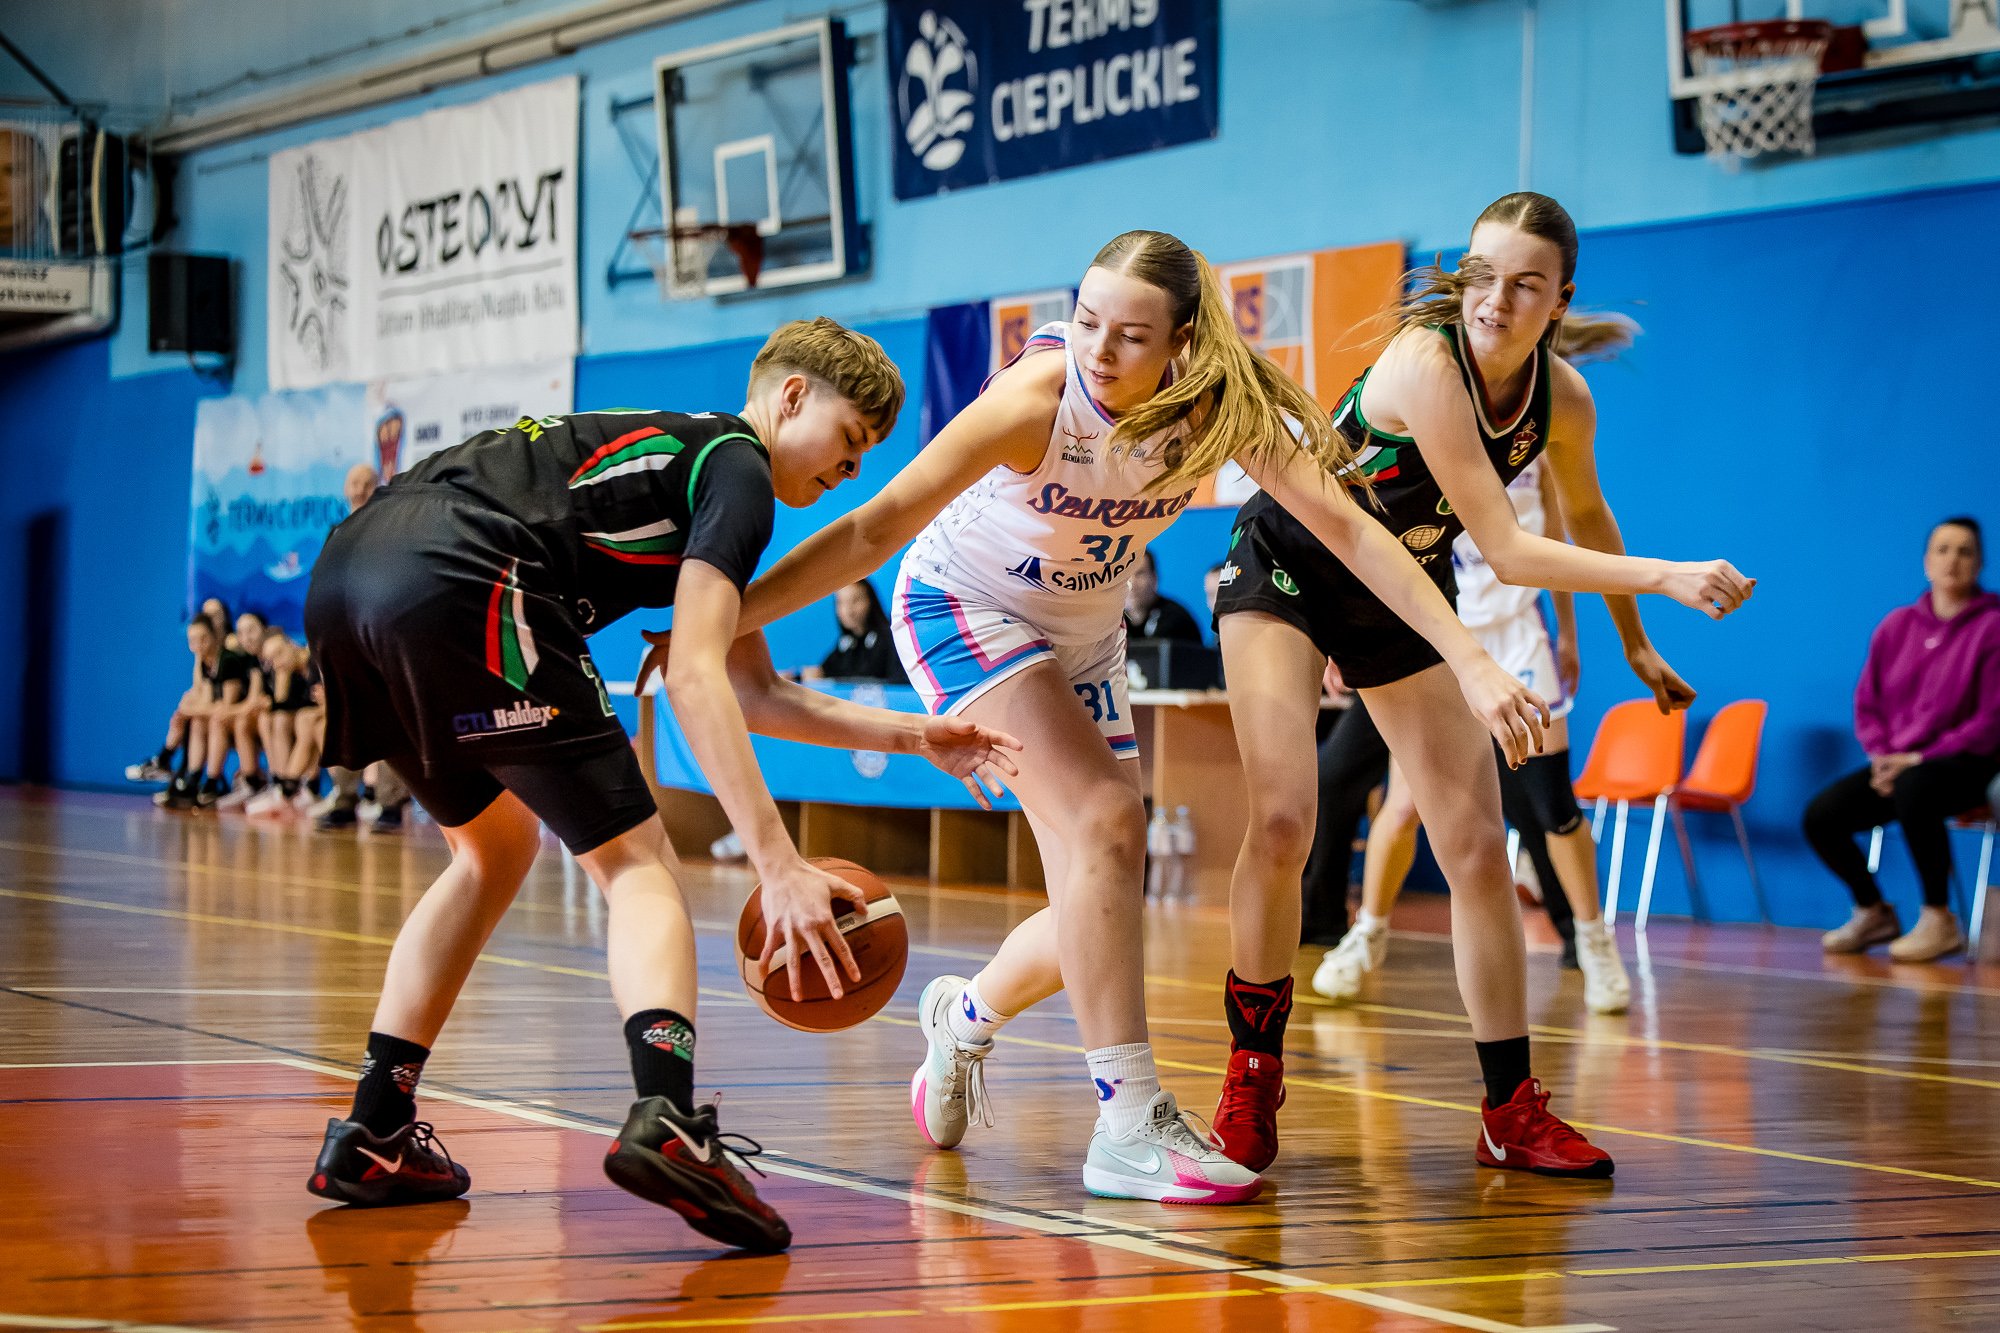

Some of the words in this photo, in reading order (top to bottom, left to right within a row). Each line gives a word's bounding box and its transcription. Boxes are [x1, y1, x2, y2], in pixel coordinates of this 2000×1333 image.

[991, 37, 1200, 142] CIEPLICKIE
[377, 167, 563, 276] OSTEOCYT
[1027, 483, 1197, 528] SPARTAKUS
[1070, 535, 1134, 566] 31
[1073, 680, 1120, 723] 31
